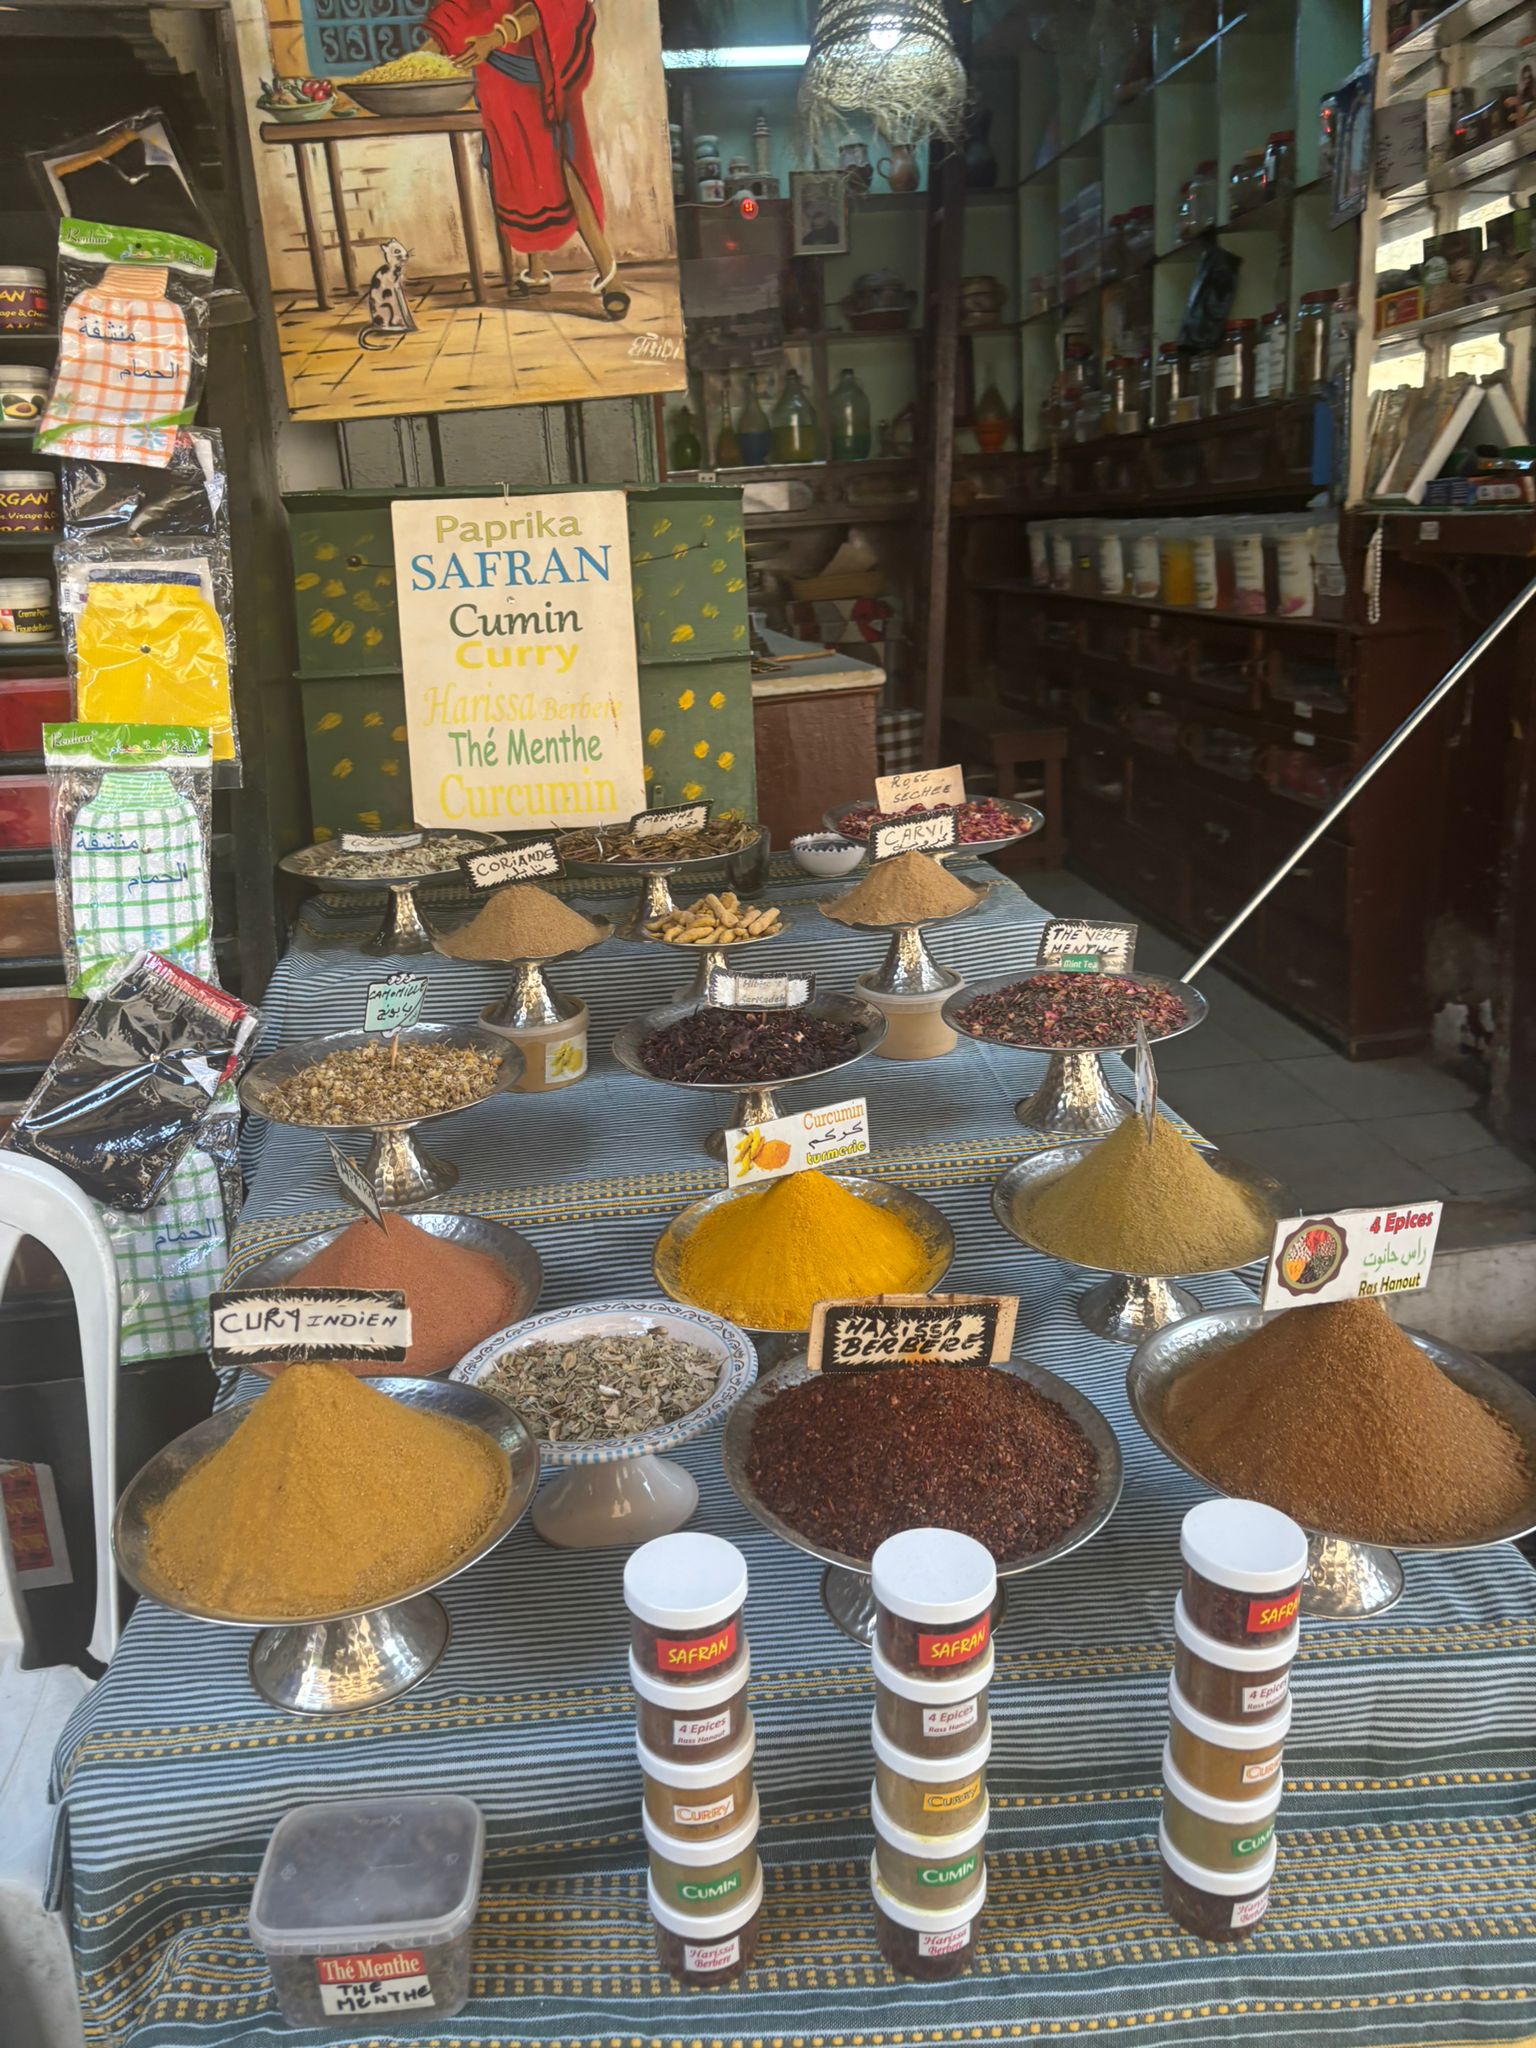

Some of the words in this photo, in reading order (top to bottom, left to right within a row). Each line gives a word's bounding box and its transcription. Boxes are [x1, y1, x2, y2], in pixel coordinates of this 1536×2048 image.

[80, 316, 136, 342] منشفة
[119, 358, 179, 380] الحمام
[435, 510, 583, 548] Paprika
[411, 545, 612, 591] SAFRAN
[450, 601, 583, 638] Cumin
[455, 640, 579, 673] Curry
[421, 682, 536, 726] Harissa
[448, 727, 499, 767] Thé
[507, 725, 603, 766] Menthe
[439, 767, 618, 820] Curcumin
[890, 773, 930, 788] ROSE
[76, 831, 139, 851] منشفة
[127, 862, 189, 894] الحمام
[1053, 928, 1082, 940] THE
[1085, 931, 1122, 941] VERT
[1051, 944, 1119, 955] MENTHE
[803, 1101, 864, 1130] Curcumin
[808, 1120, 863, 1150] كركم
[806, 1139, 866, 1166] turmeric
[155, 1218, 217, 1254] الحمام
[1369, 1216, 1381, 1234] 4
[1384, 1210, 1434, 1235] Epices
[1358, 1279, 1378, 1297] Ras
[1381, 1272, 1421, 1293] Hanout
[841, 1333, 986, 1357] BERBERE
[1259, 1596, 1300, 1625] SAFRA
[668, 1635, 729, 1665] SAFRAN
[930, 1625, 985, 1659] SAFRAN
[1249, 1690, 1257, 1700] 4
[691, 1717, 726, 1735] Epices
[928, 1714, 936, 1723] 4
[939, 1706, 974, 1723] Epices
[923, 1928, 967, 1946] Harissa
[688, 1943, 735, 1959] Harissa
[322, 1959, 354, 1981] Thé
[357, 1954, 421, 1978] Menthe
[336, 1982, 382, 1996] THE
